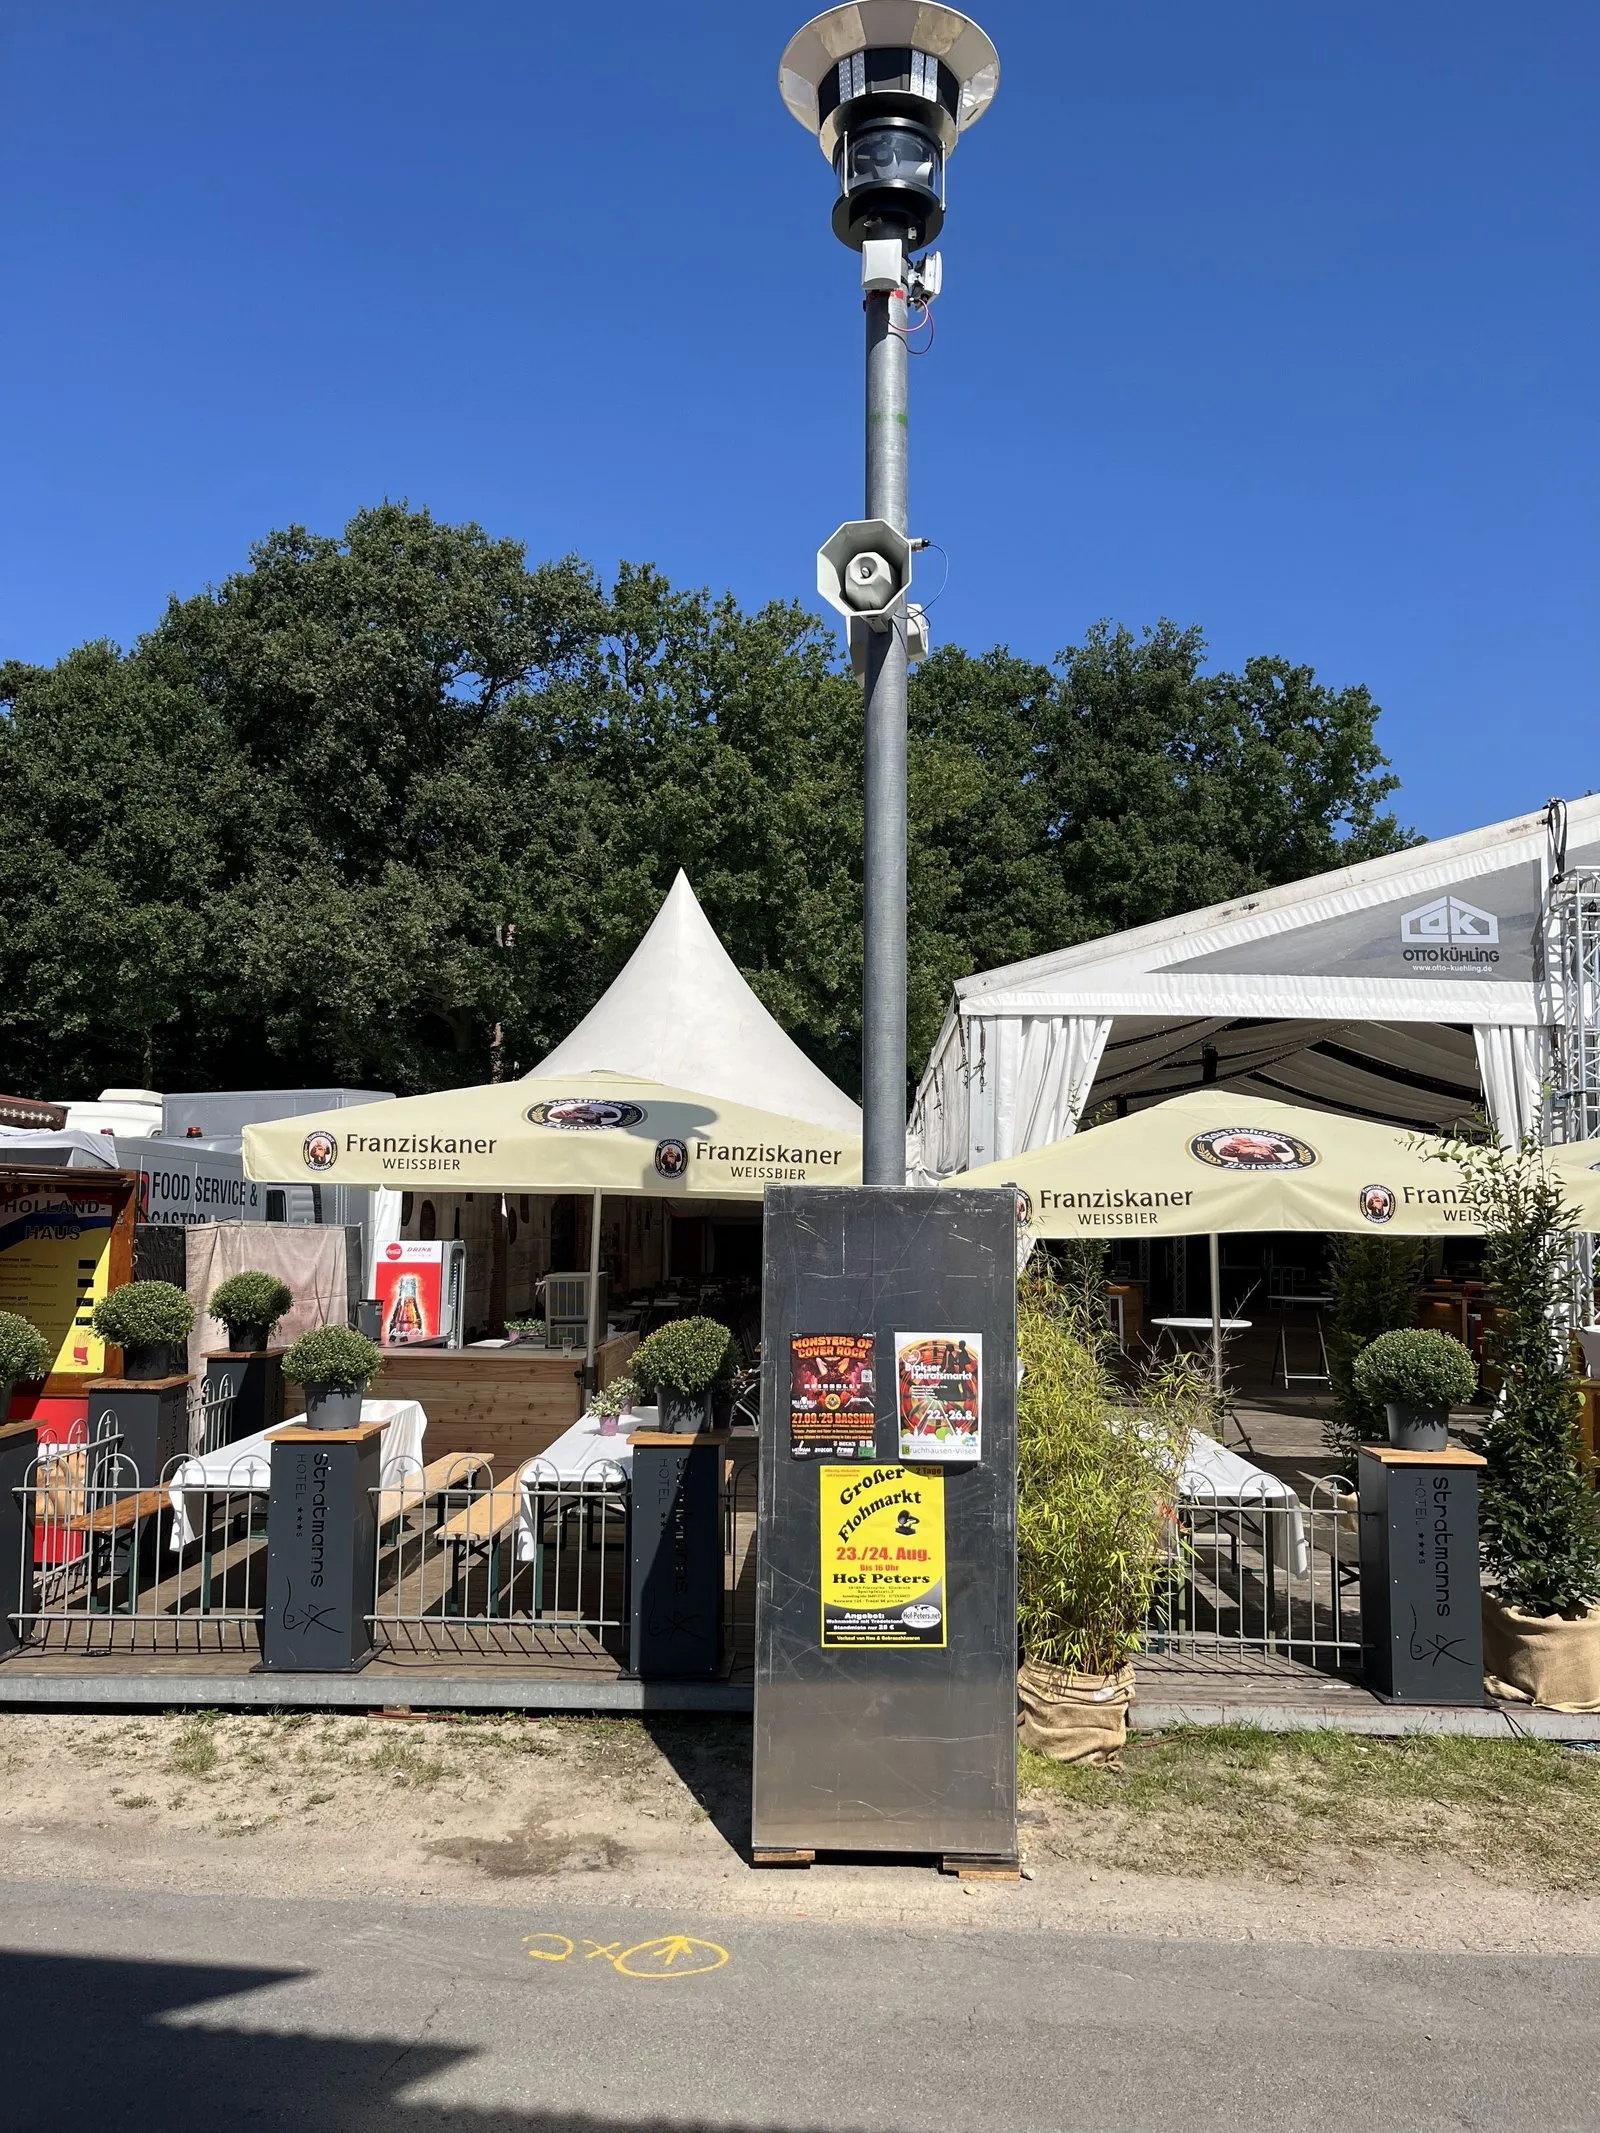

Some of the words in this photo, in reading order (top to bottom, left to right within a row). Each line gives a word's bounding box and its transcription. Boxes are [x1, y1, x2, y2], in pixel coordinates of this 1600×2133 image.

[1402, 949, 1439, 961] OTTO
[1412, 964, 1493, 974] www.otto-kuehling.de
[346, 1133, 498, 1154] Franziskaner
[696, 1142, 842, 1165] Franziskaner
[382, 1158, 461, 1170] WEISSBIER
[731, 1166, 806, 1180] WEISSBIER
[152, 1171, 190, 1201] FOOD
[195, 1176, 247, 1206] SERVICE
[249, 1183, 258, 1207] &
[1040, 1188, 1193, 1209] Franziskaner
[4, 1200, 106, 1214] HOLLAND-
[1077, 1212, 1159, 1225] WEISSBIER
[25, 1225, 80, 1240] HAUS
[792, 1336, 855, 1350] MONSTERS
[857, 1338, 874, 1350] OF
[798, 1346, 834, 1359] COVER
[836, 1346, 868, 1359] ROCK
[904, 1362, 942, 1374] Brokser
[911, 1370, 973, 1381] Heiratsmarkt
[834, 1413, 875, 1425] BASSUM
[296, 1453, 307, 1500] HOTEL
[659, 1457, 670, 1505] HOTEL
[839, 1467, 906, 1506] Großer
[1415, 1477, 1427, 1525] HOTEL
[837, 1488, 922, 1544] Flohmarkt
[836, 1546, 893, 1561] 23./24.
[895, 1546, 932, 1562] Aug.
[833, 1573, 867, 1584] Hof
[871, 1573, 931, 1584] Peters
[844, 1612, 885, 1621] Angebot:
